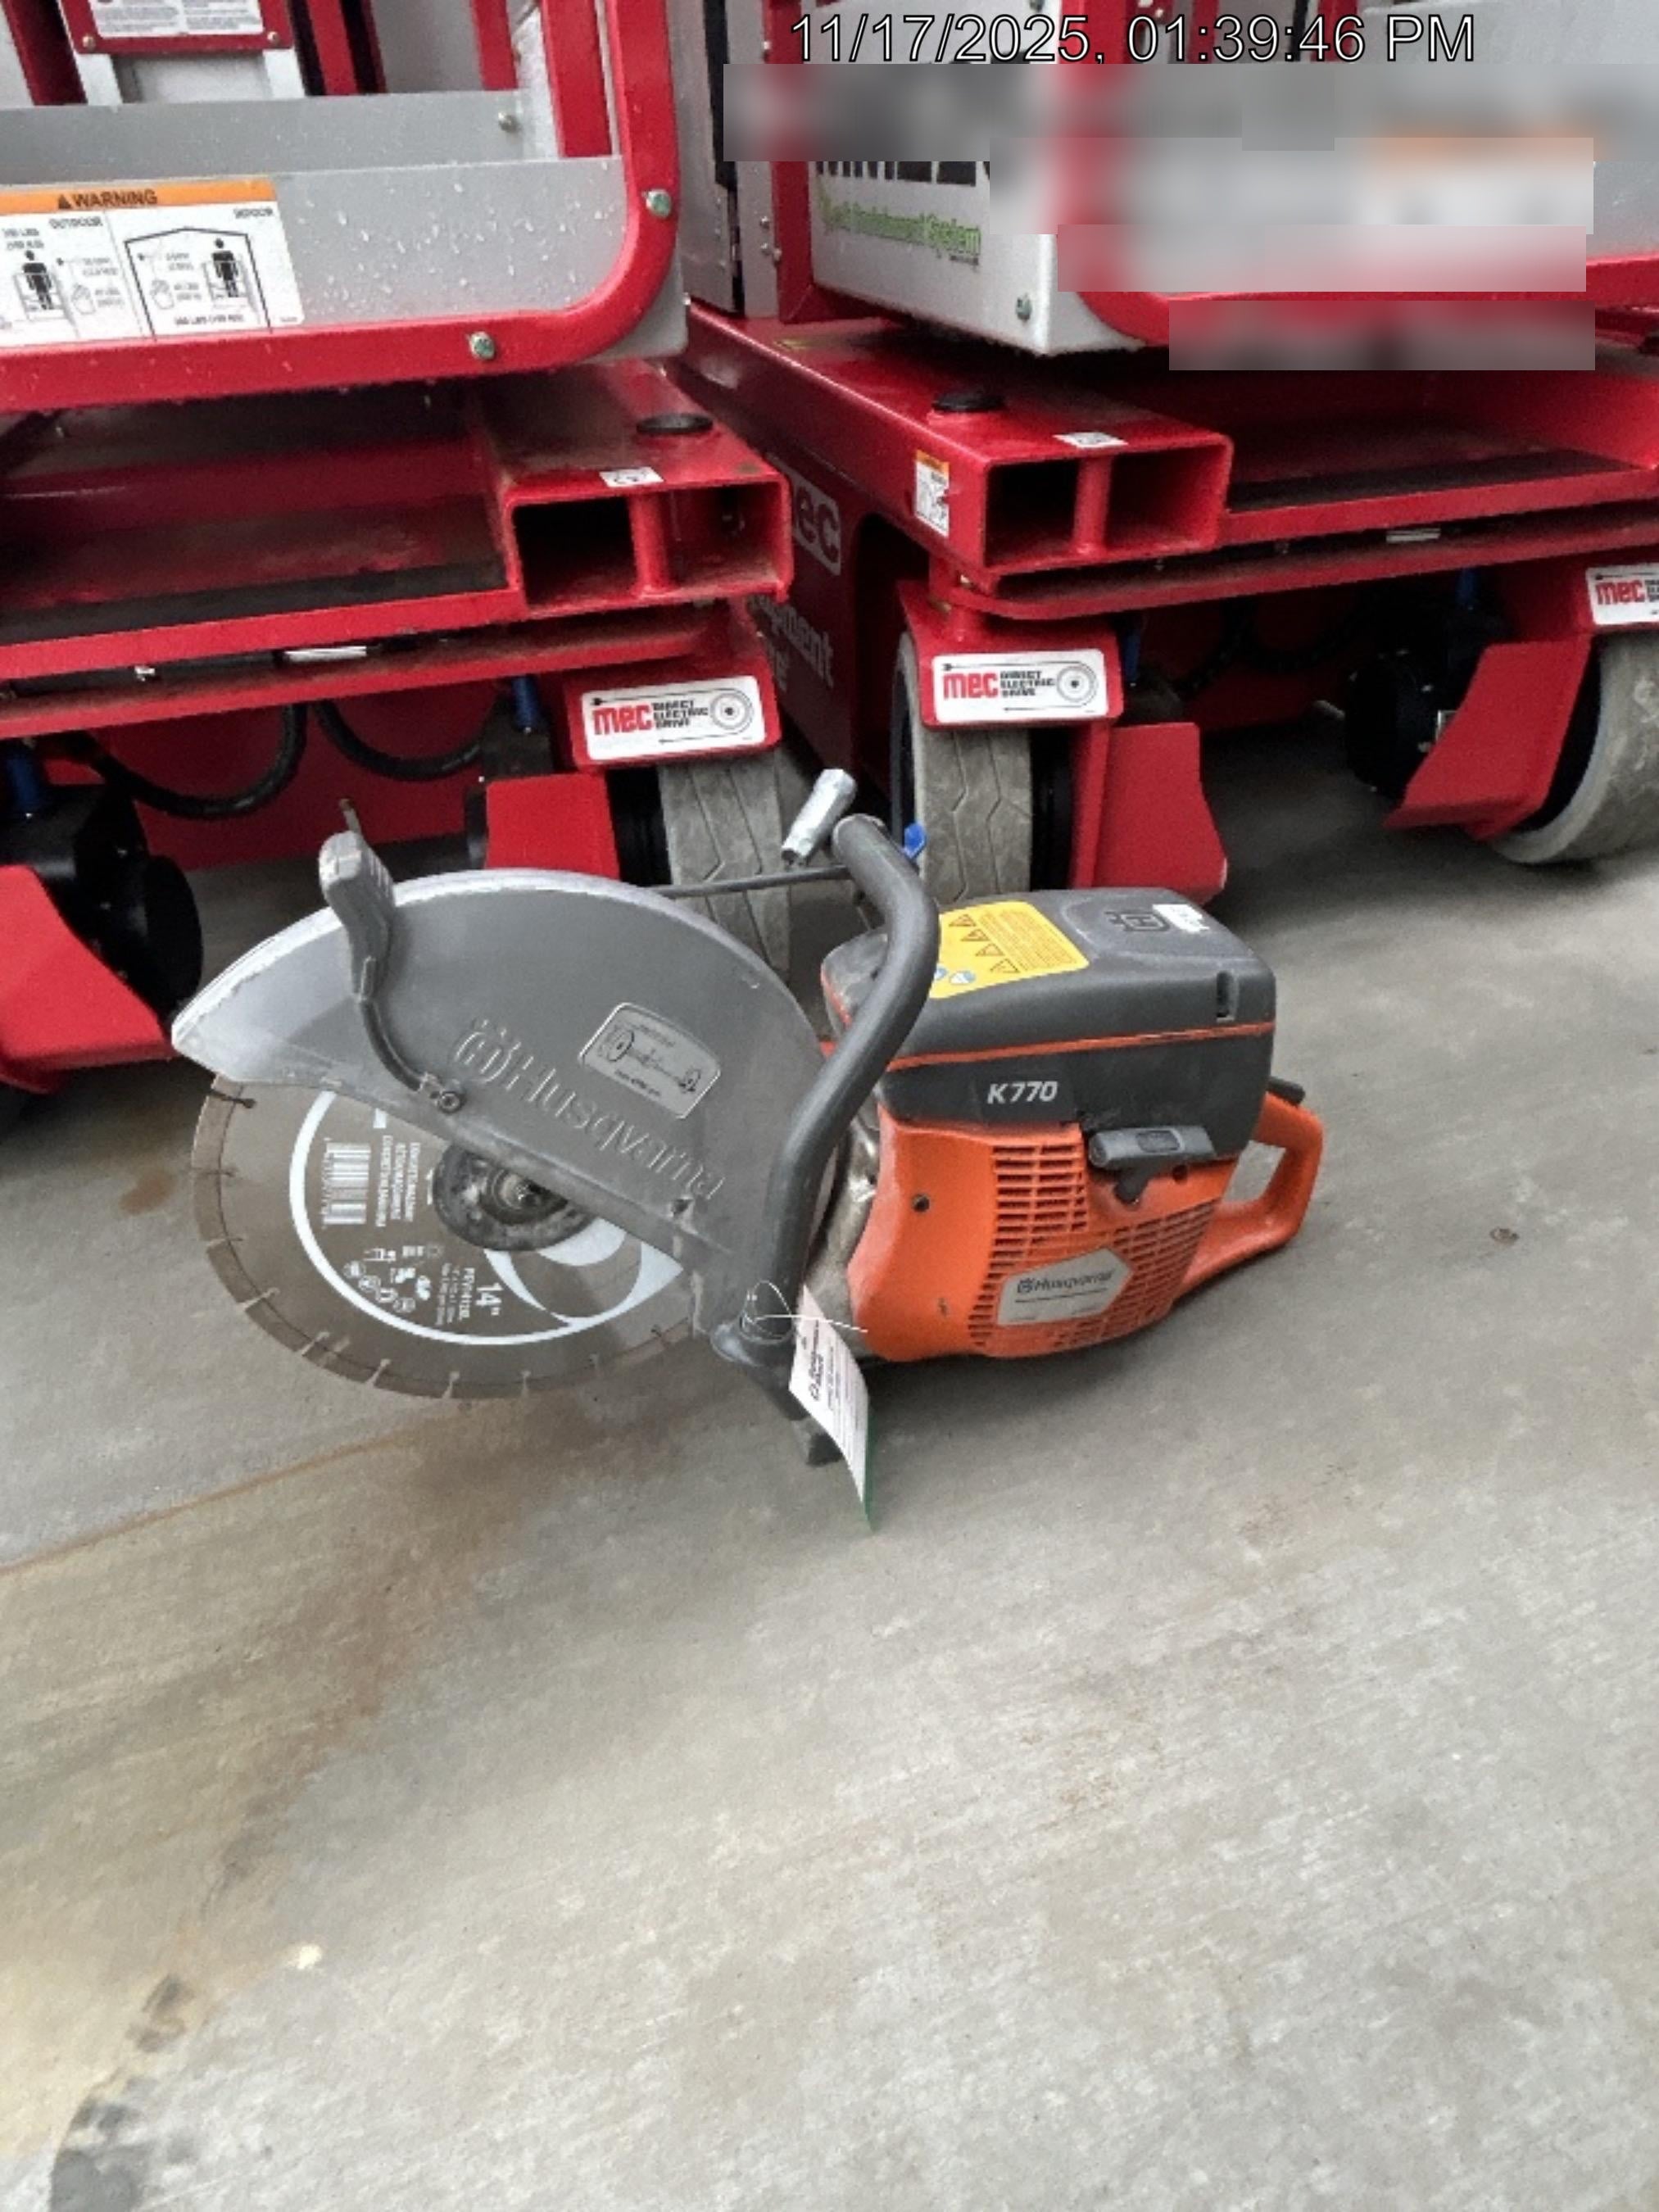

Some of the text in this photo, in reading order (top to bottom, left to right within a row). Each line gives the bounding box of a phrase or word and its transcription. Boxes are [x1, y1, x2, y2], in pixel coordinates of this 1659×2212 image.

[72, 189, 158, 206] WARNING
[1594, 579, 1646, 605] mec
[943, 672, 999, 700] mec
[1000, 671, 1042, 679] DIRECT
[1000, 678, 1055, 688] ELECTRIC
[593, 705, 653, 735] mec
[505, 1054, 726, 1201] Husqvarna
[1035, 1268, 1115, 1291] Husqvarna
